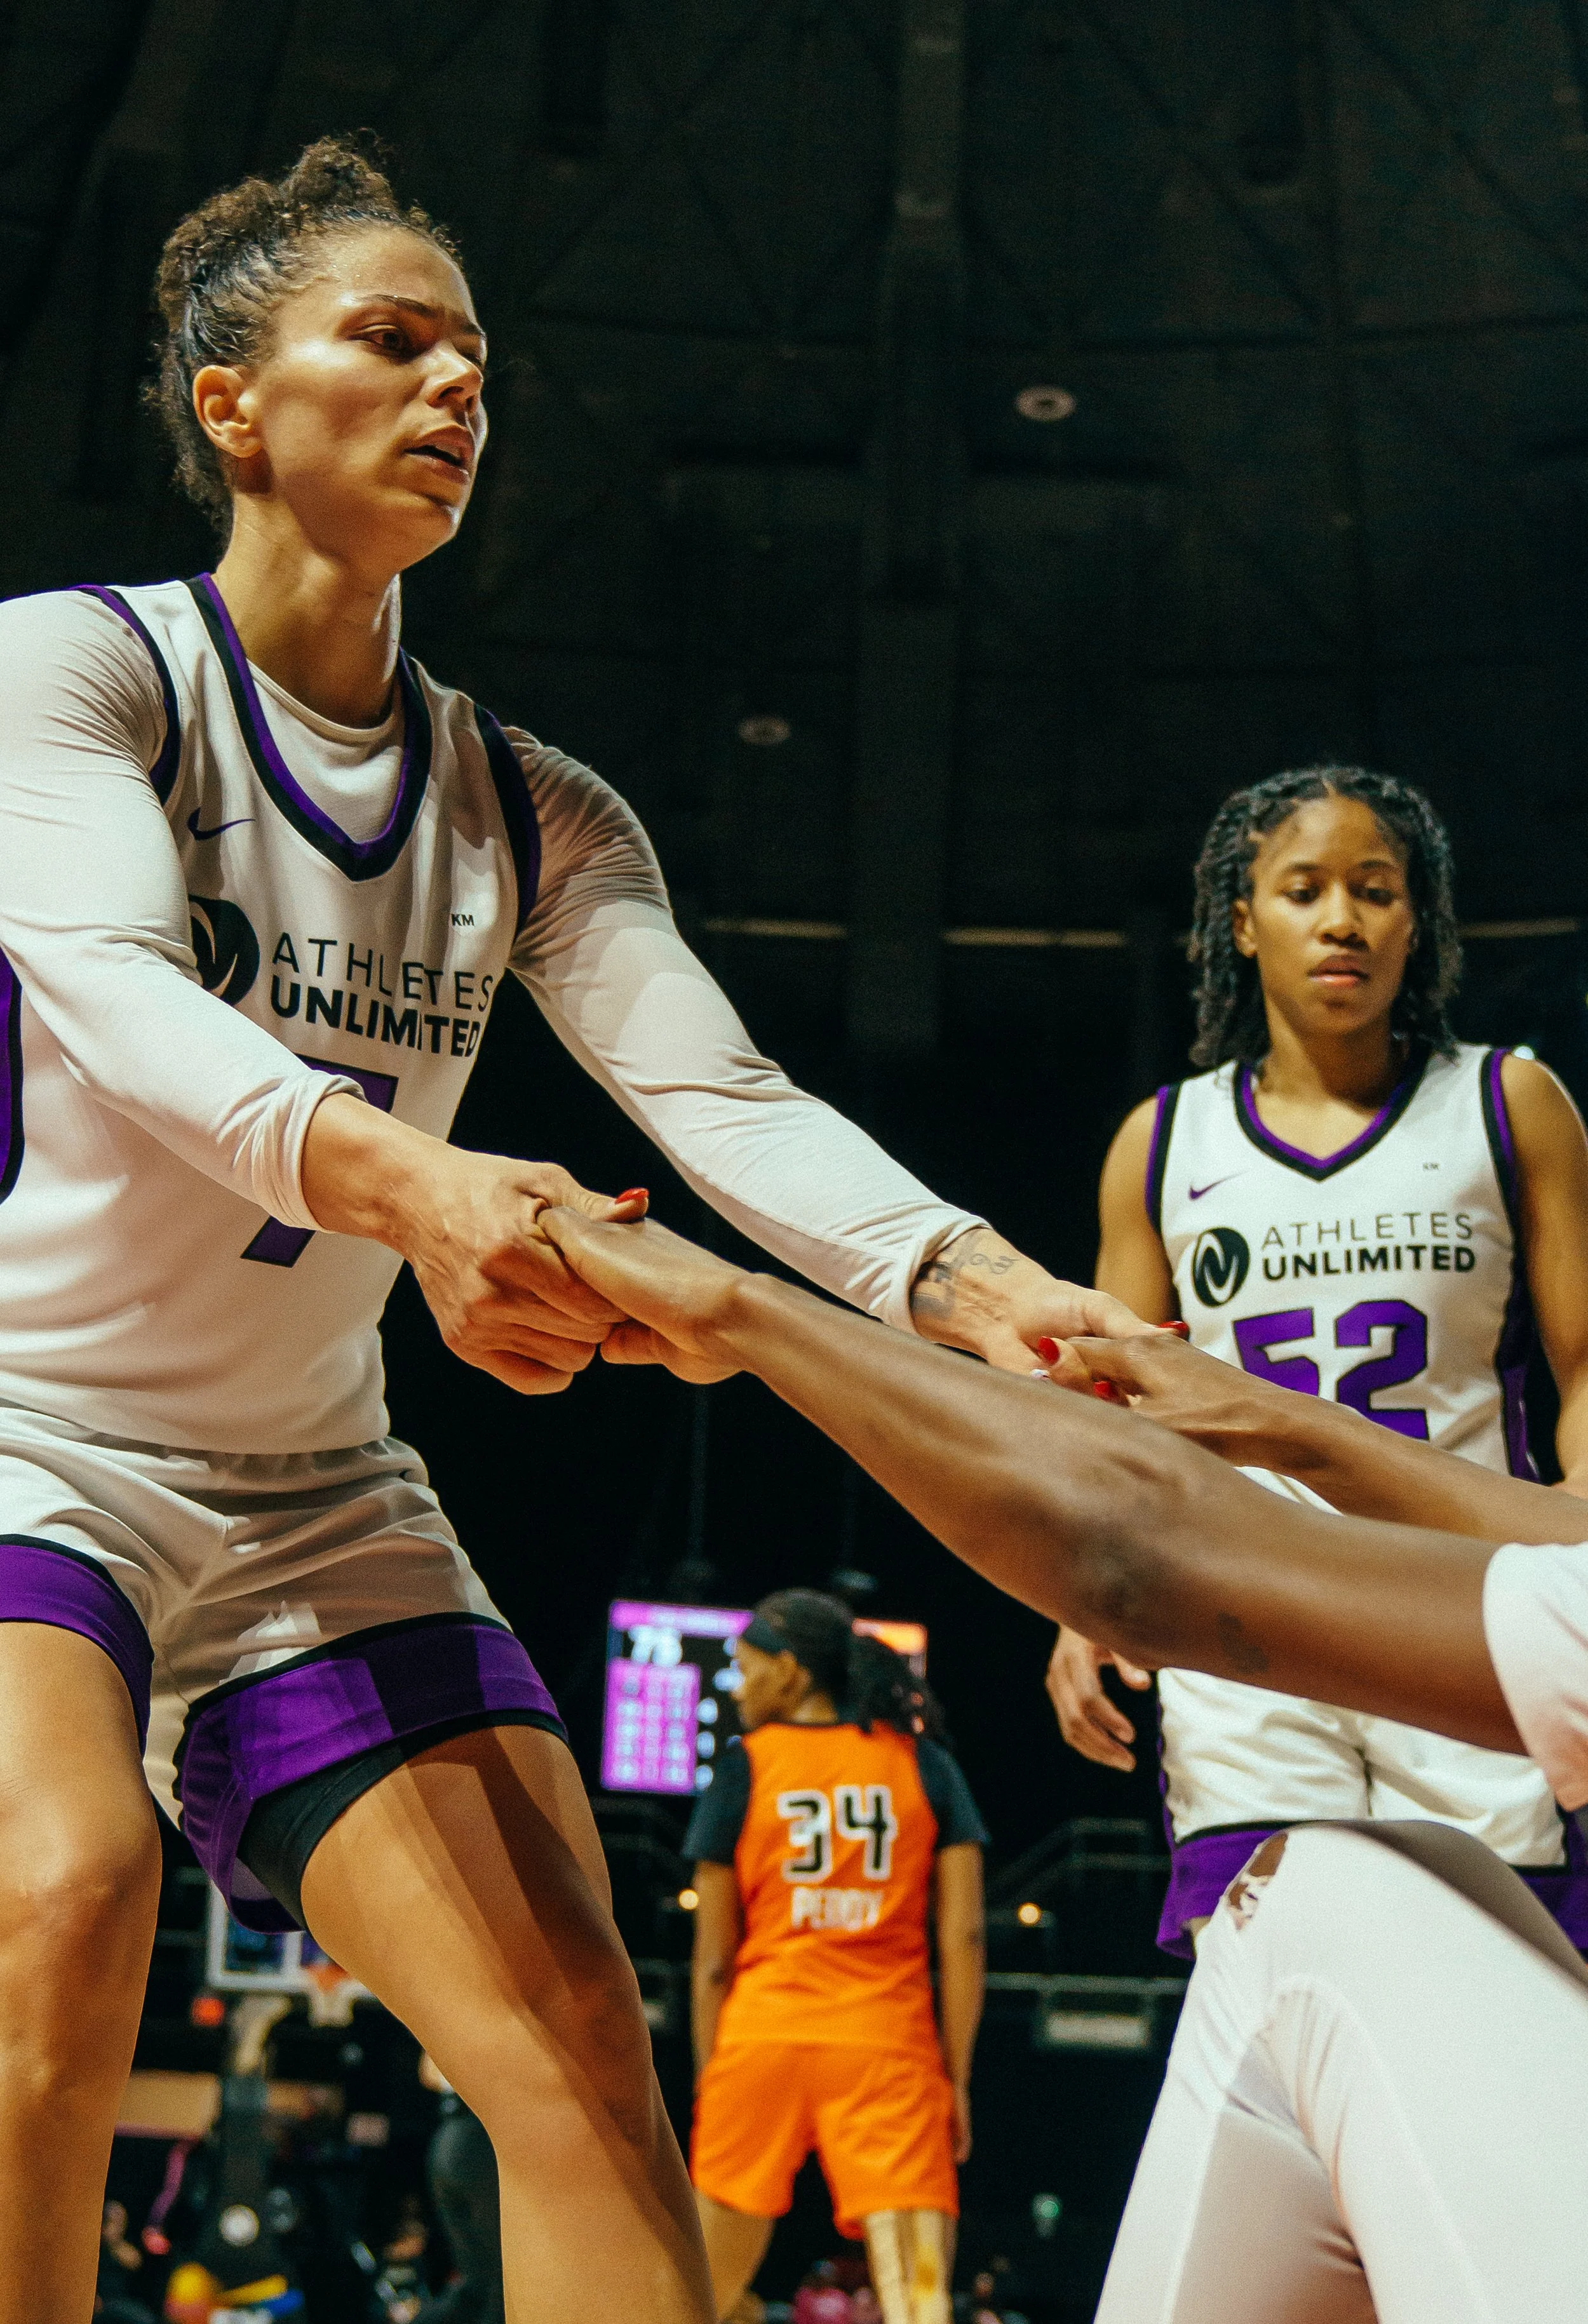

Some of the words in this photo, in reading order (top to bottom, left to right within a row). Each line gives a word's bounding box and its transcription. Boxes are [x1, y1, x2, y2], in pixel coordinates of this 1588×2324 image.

[451, 913, 474, 926] KM
[272, 932, 494, 1012] ATHLETES
[271, 974, 481, 1058] UNLIMITED
[1261, 1211, 1473, 1250] ATHLETES
[1262, 1244, 1476, 1281] UNLIMITED
[1232, 1299, 1429, 1441] 52
[777, 1783, 898, 1883] 34
